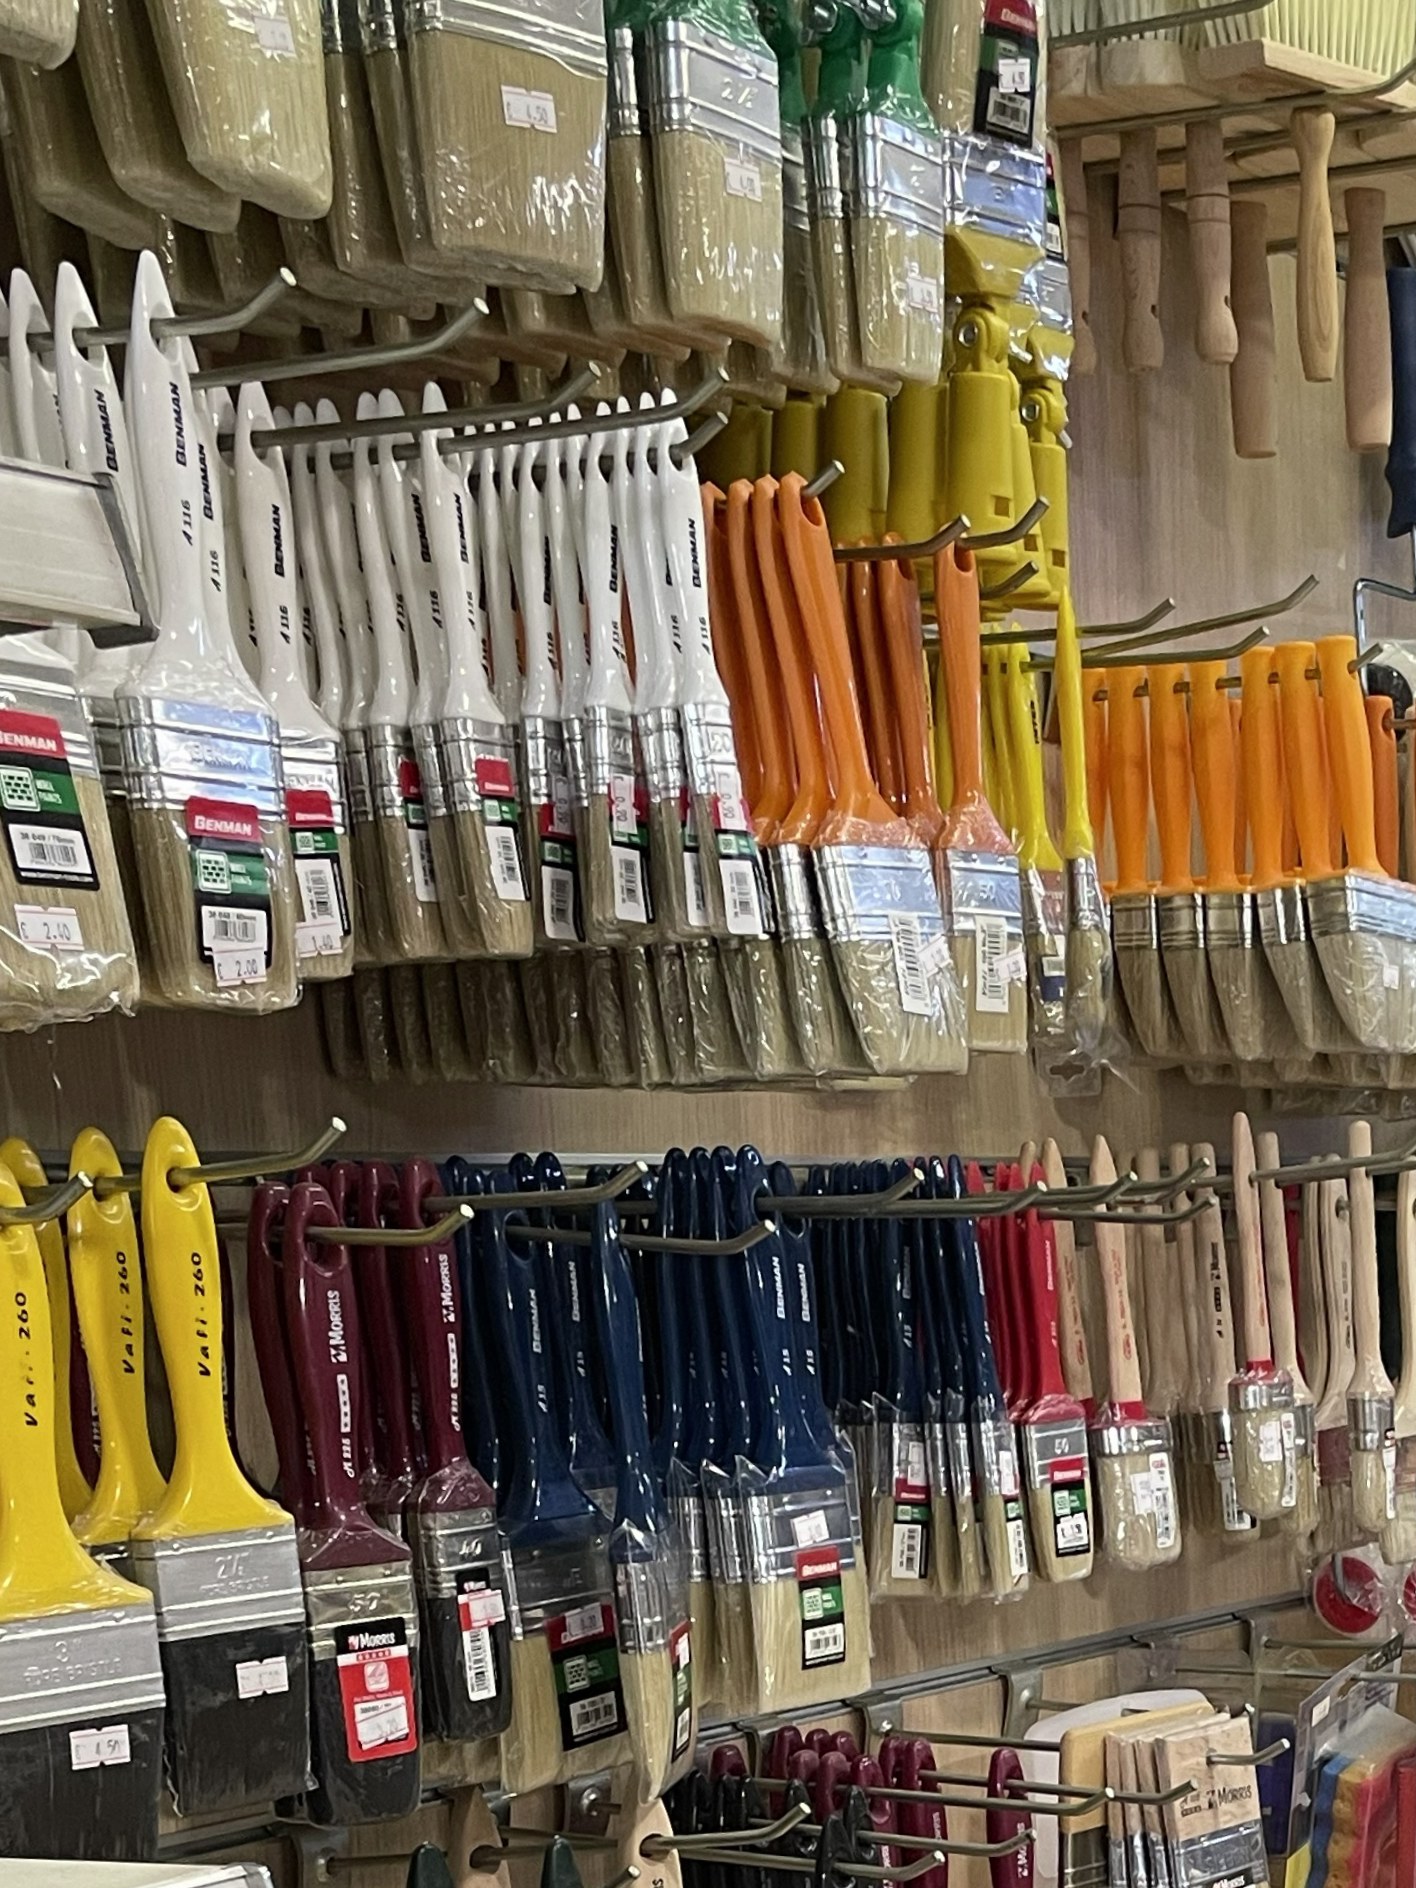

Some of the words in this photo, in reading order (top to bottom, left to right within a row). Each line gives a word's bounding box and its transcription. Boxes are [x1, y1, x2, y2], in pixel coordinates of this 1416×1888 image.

[94, 389, 119, 472] BENMAN
[169, 382, 187, 467] BENMAN
[198, 443, 214, 521] BENMAN
[274, 504, 286, 578] BENMAN
[609, 524, 618, 594] BENMAN
[688, 518, 702, 588] BENMAN
[194, 815, 252, 836] BENMAN
[43, 921, 71, 941] 2.40
[116, 1251, 130, 1295] 260
[191, 1252, 205, 1297] 260
[568, 1261, 580, 1322] BENMAN
[772, 1256, 786, 1320] BENMAN
[797, 1263, 810, 1322] BENMAN
[15, 1292, 31, 1340] 260
[121, 1314, 135, 1375] Vafi
[327, 1290, 345, 1347] MORRIS
[528, 1288, 543, 1354] BENMAN
[195, 1317, 211, 1377] Vafi
[359, 1632, 396, 1648] MORRIS
[1217, 1784, 1252, 1807] MORRIS
